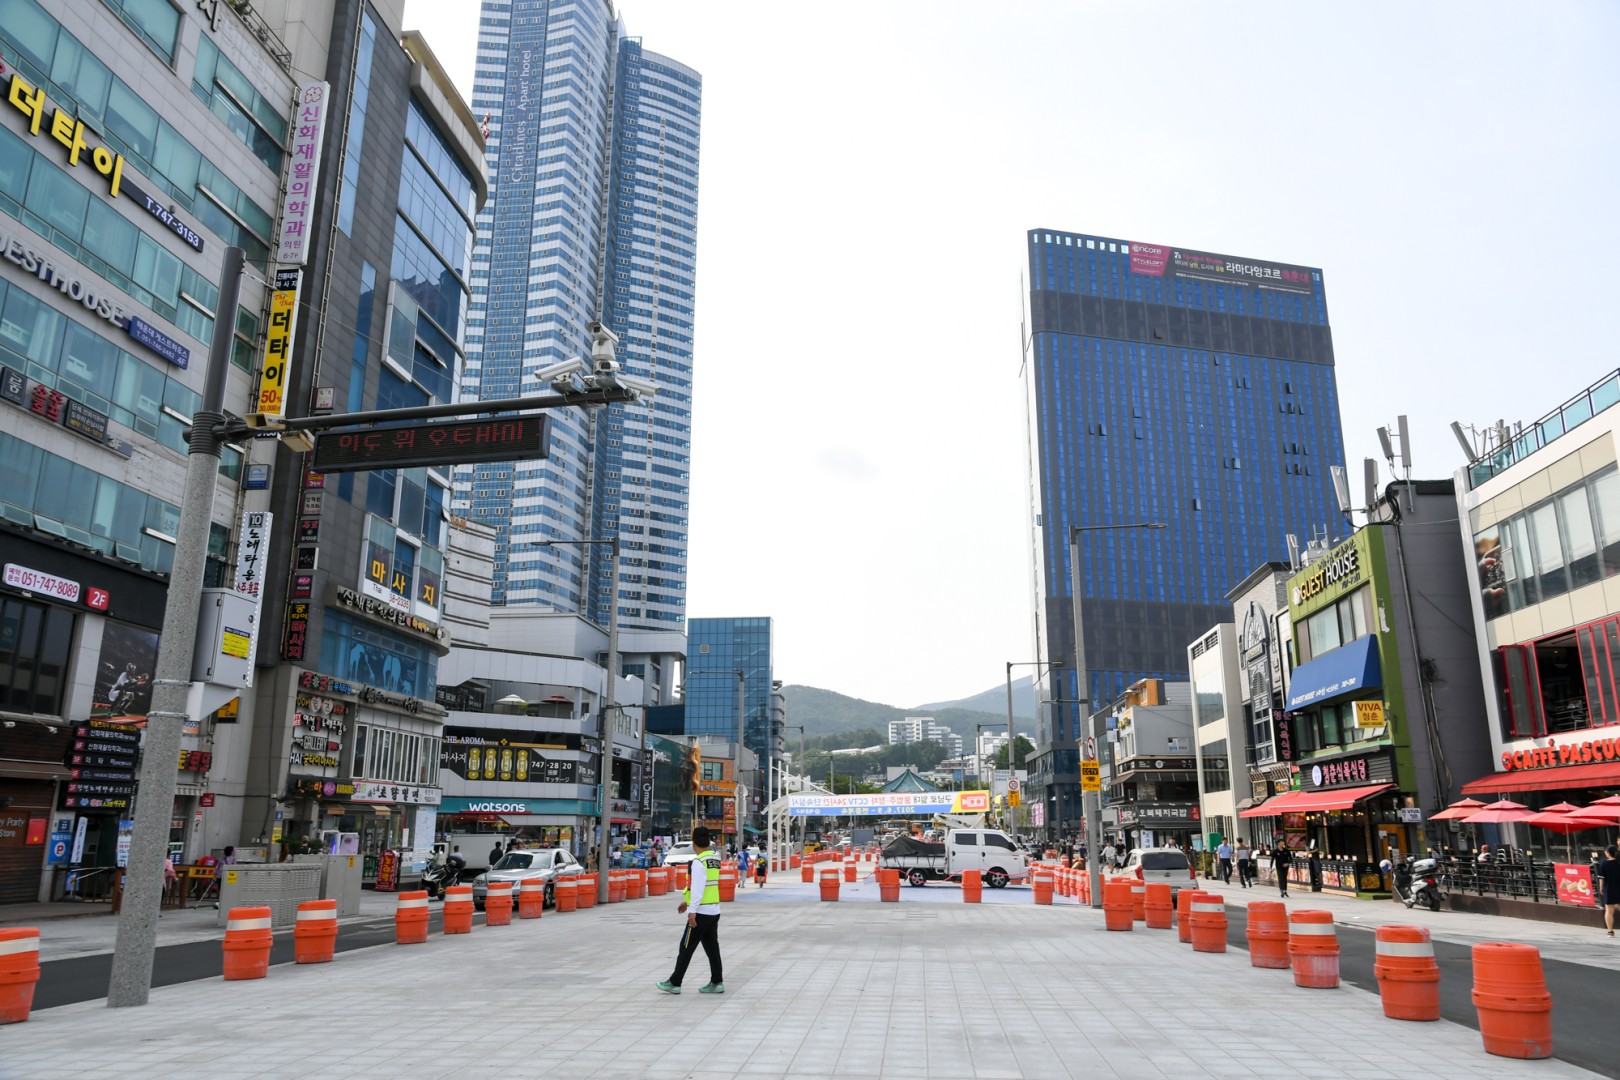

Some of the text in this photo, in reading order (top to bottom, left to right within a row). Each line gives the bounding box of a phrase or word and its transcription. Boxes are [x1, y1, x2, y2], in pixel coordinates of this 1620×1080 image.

[8, 73, 124, 198] 더타이
[511, 120, 526, 183] Citadines
[284, 105, 320, 238] 신화재활의학과
[284, 240, 302, 249] 의원
[265, 309, 292, 387] 더타이
[177, 357, 187, 366] 4F
[250, 514, 262, 525] 10
[242, 528, 261, 582] 노래타운
[1300, 569, 1325, 600] GUEST
[1325, 550, 1357, 585] HOUSE
[22, 571, 79, 598] 051-747-8089
[91, 591, 107, 607] 2F
[288, 620, 306, 659] 마사지
[1357, 703, 1381, 711] VIVA
[1362, 712, 1379, 721] 청춘
[460, 736, 485, 745] AROMA
[441, 752, 466, 764] 마사지
[1322, 759, 1366, 784] 청춘식육식당
[469, 802, 526, 813] watsons
[6, 818, 24, 828] Party
